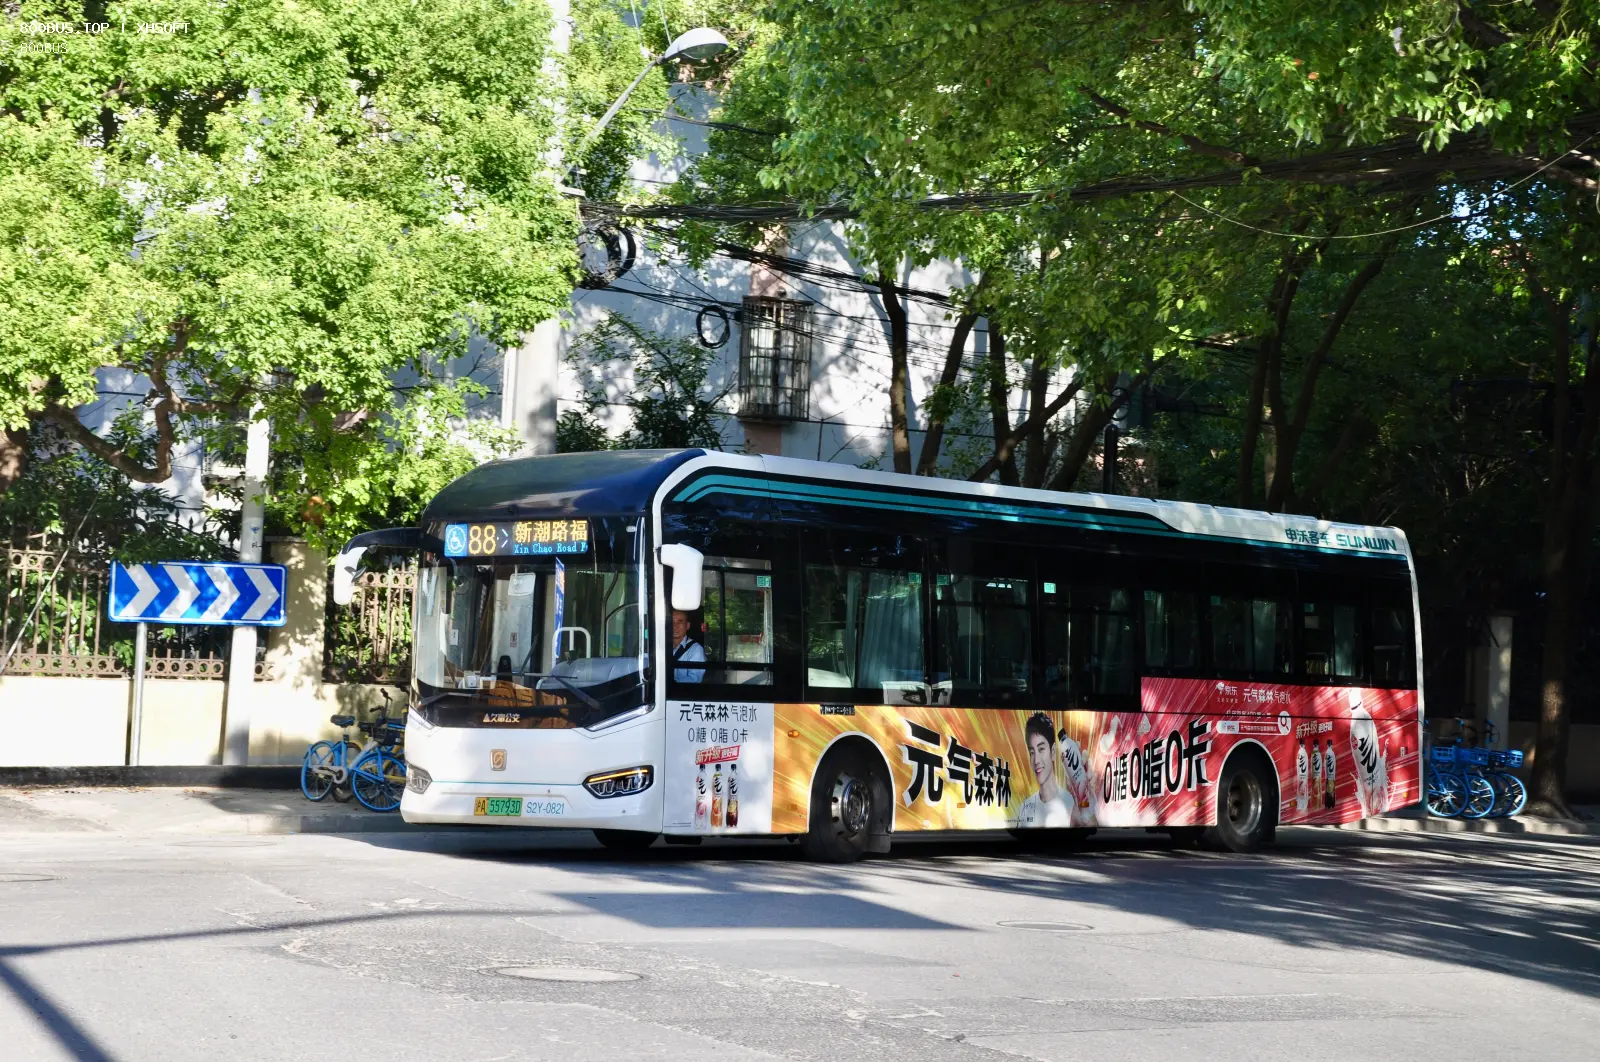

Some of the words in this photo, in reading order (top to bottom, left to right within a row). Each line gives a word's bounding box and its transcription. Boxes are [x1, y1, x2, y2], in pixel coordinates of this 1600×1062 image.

[468, 525, 496, 555] 88
[515, 520, 588, 543] 新潮路福
[1285, 528, 1329, 545] 申沃客车
[1335, 534, 1397, 551] SUNWIN
[514, 543, 529, 554] Xin
[532, 542, 553, 553] Chao
[557, 541, 577, 552] Road
[679, 703, 757, 722] 元气森林气泡水
[688, 727, 706, 743] 0糖
[711, 727, 728, 743] 0脂
[732, 728, 748, 743] 0卡
[897, 717, 1011, 807] 元气森林
[1103, 717, 1213, 804] 0糖0脂0卡
[489, 800, 521, 814] 55793D
[526, 801, 565, 815] S2Y-0821
